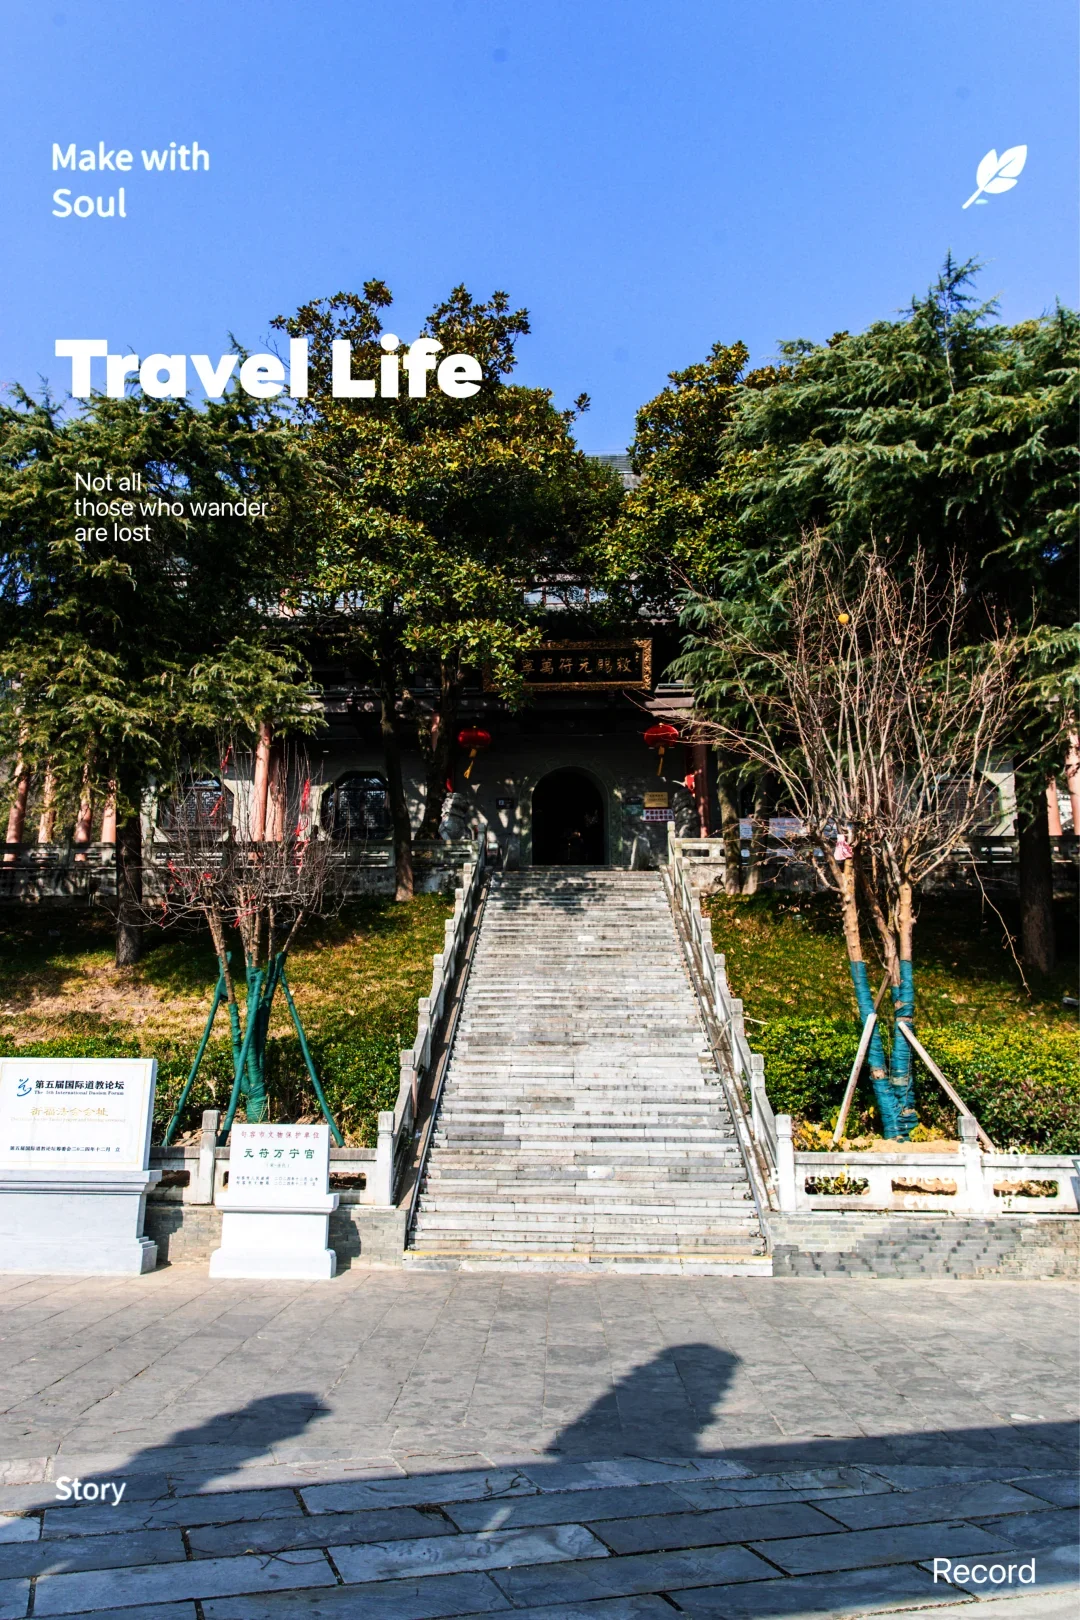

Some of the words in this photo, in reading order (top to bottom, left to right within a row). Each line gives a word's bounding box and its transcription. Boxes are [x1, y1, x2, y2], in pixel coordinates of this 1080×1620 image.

[35, 1079, 125, 1090] 第五届国际道教论坛
[241, 1130, 320, 1140] 句容市文物保护单位
[243, 1148, 315, 1160] 元符万宁宫
